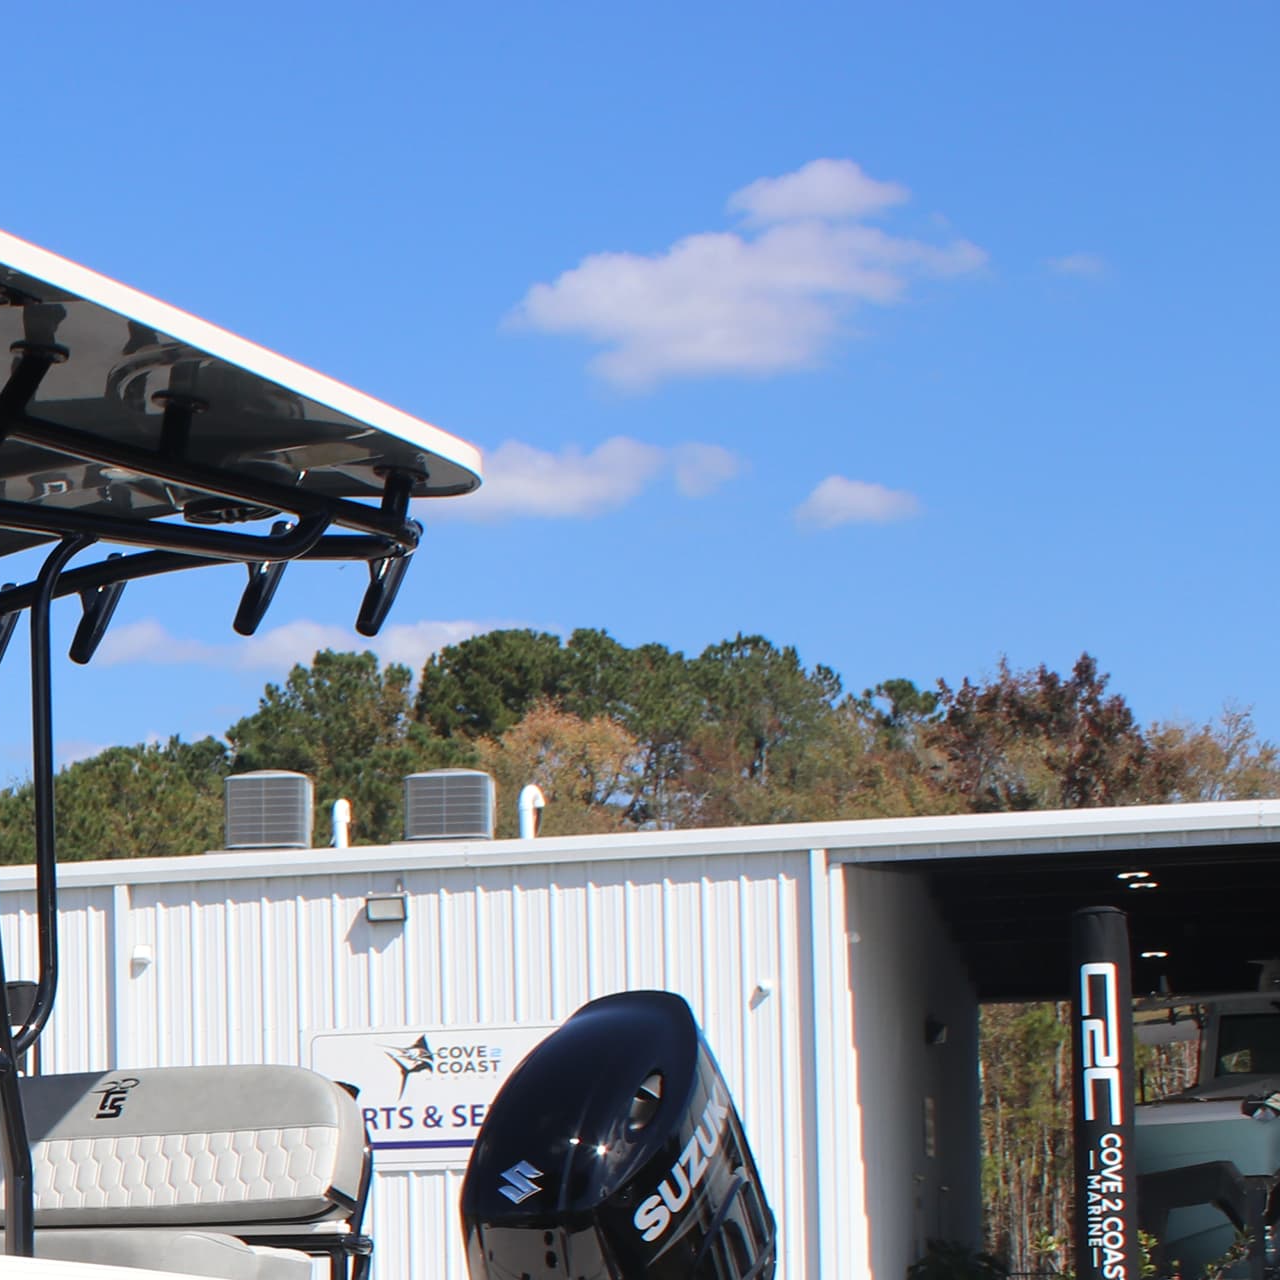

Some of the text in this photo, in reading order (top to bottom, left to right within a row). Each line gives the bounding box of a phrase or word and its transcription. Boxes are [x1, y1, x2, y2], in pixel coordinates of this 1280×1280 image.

[436, 1045, 502, 1060] COVE 2
[436, 1060, 501, 1074] COAST
[362, 1103, 490, 1130] RTS & SE
[633, 1082, 729, 1242] SUZUK
[1100, 1132, 1124, 1194] COVE
[1087, 1175, 1103, 1247] MARINE
[1101, 1198, 1124, 1212] 2
